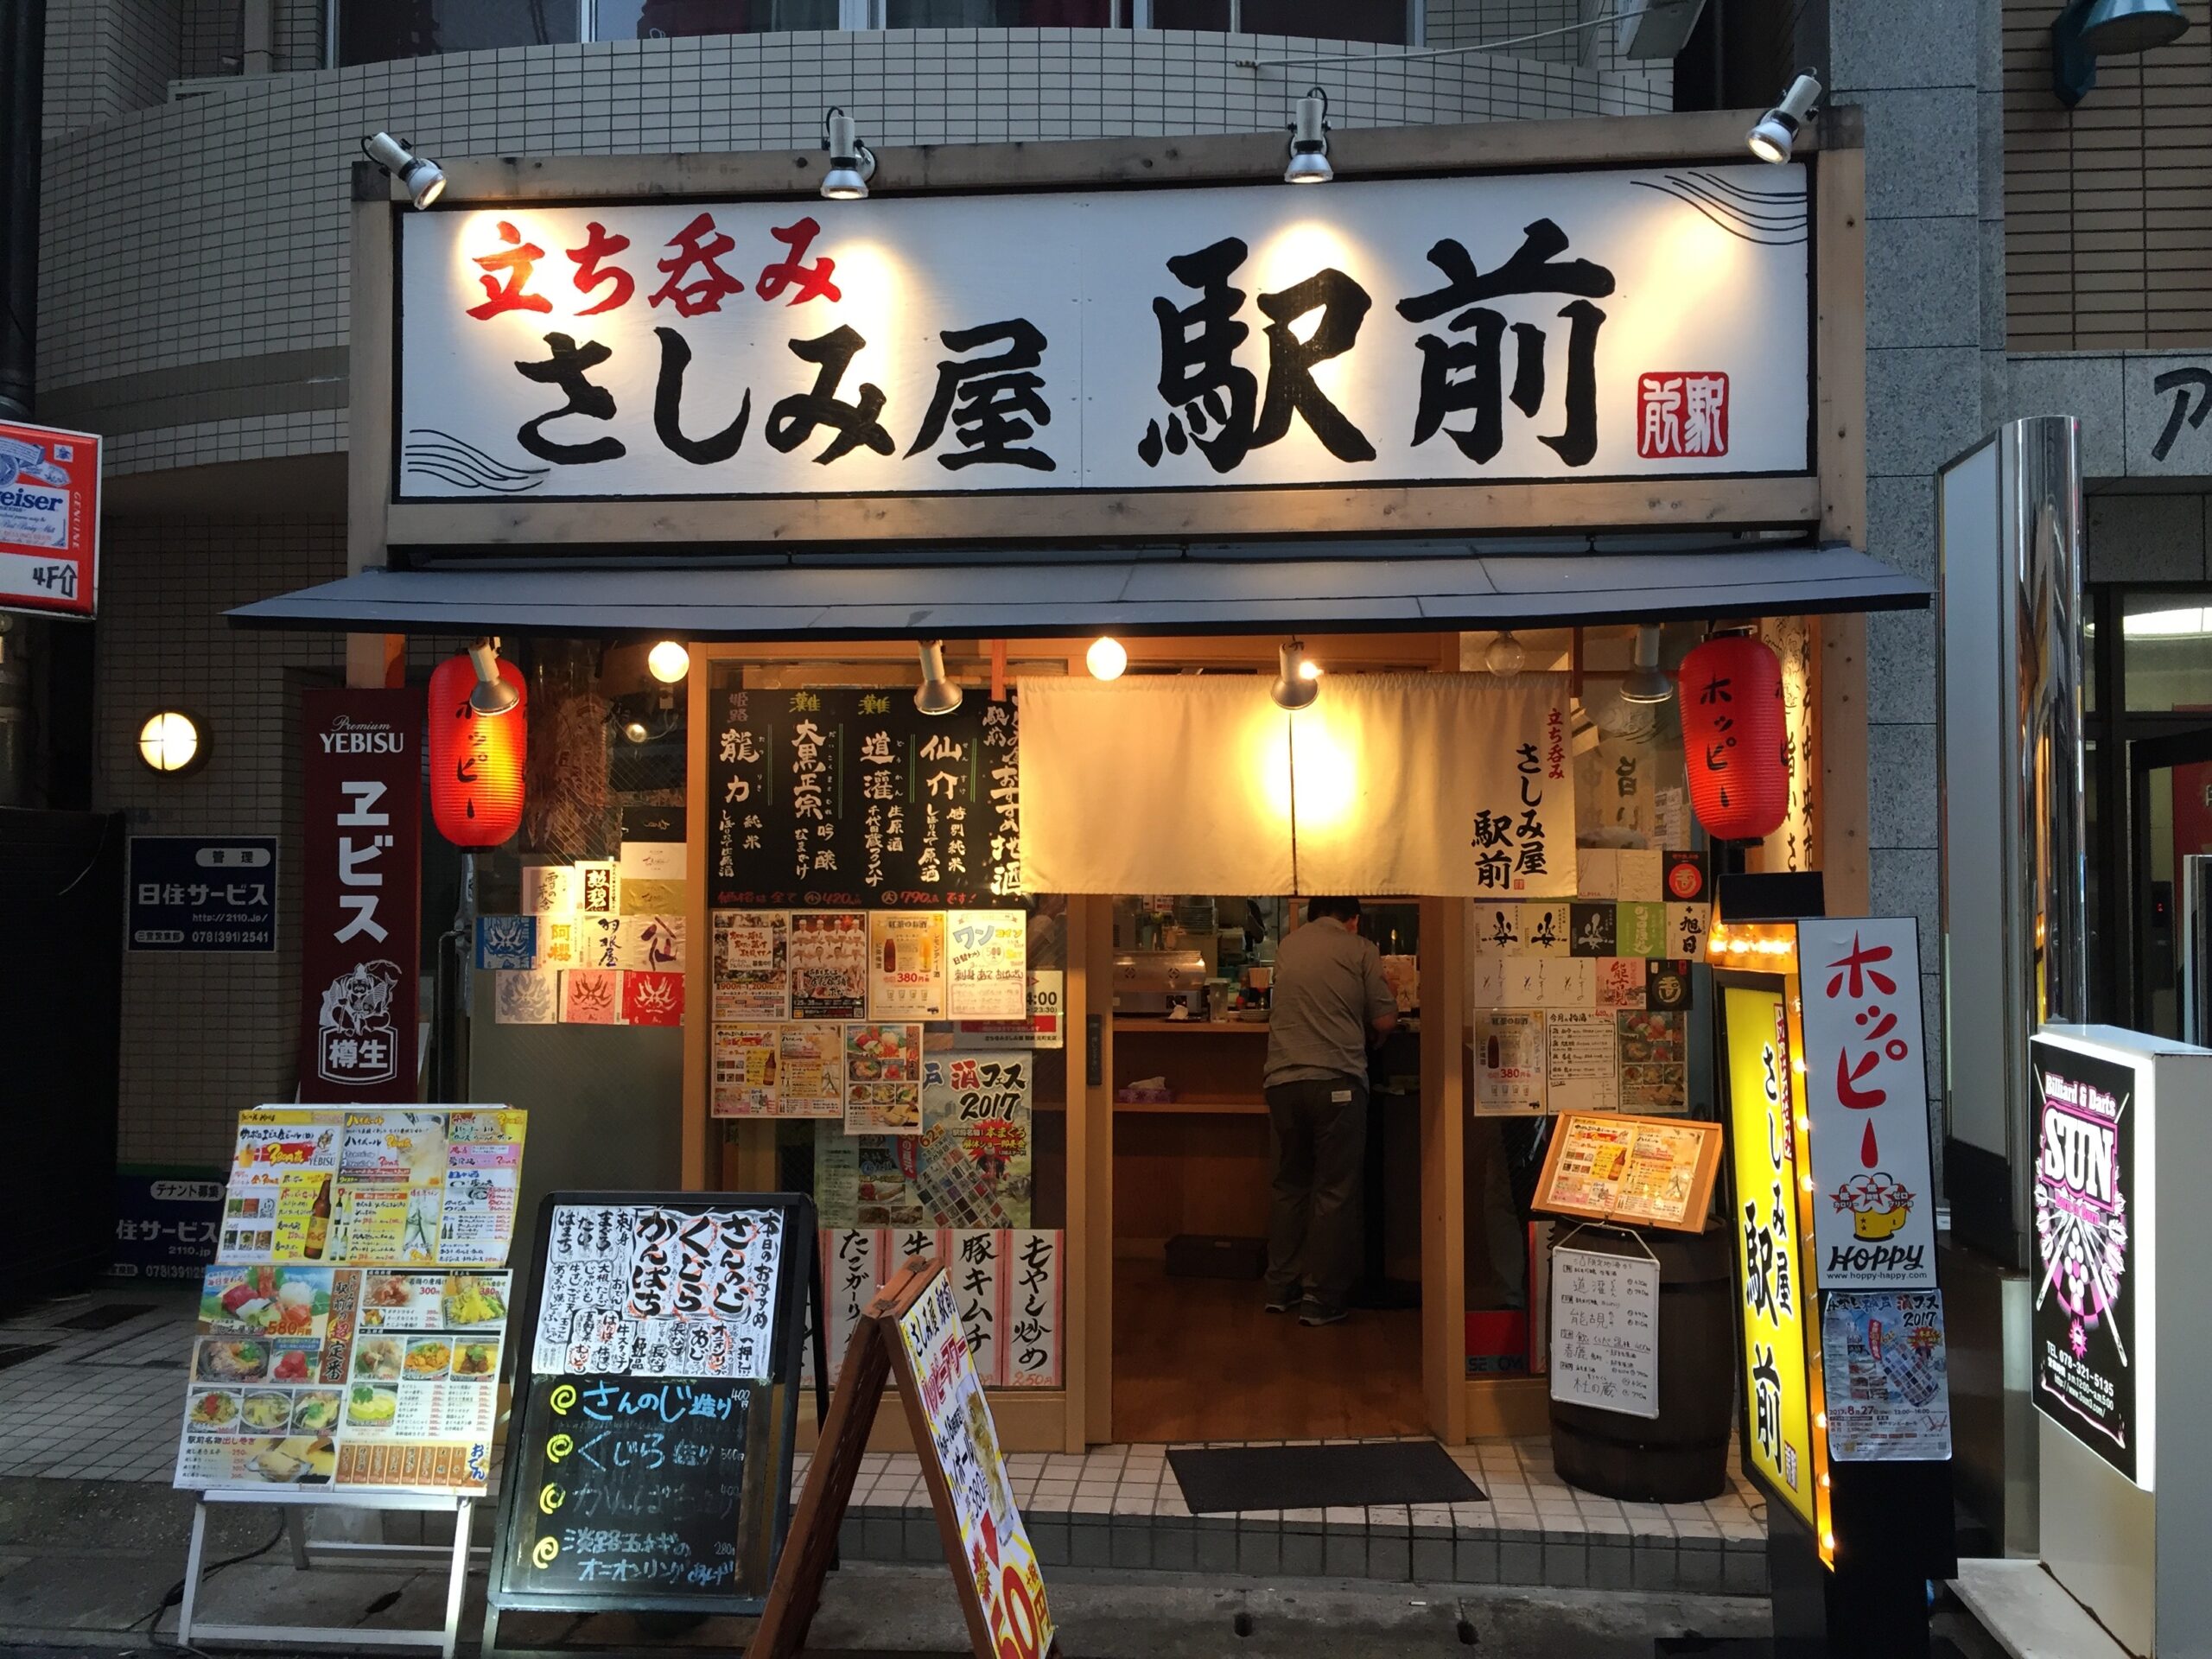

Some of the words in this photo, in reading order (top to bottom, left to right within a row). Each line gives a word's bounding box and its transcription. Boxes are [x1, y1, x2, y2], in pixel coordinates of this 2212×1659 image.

[466, 213, 842, 321] 立ち呑み
[514, 318, 1057, 472] さしみ屋
[1138, 217, 1616, 474] 駅前
[0, 488, 63, 512] eiser
[72, 491, 81, 549] GENUINE
[331, 715, 391, 732] Premium
[728, 692, 750, 723] 姫路
[319, 733, 404, 753] YEBISU
[720, 728, 760, 804] 龍力
[791, 719, 827, 820] 大黒正宗
[919, 734, 963, 800] 仙介
[1547, 708, 1565, 780] 立ち呑み
[1700, 674, 1737, 808] ホッピー
[743, 814, 763, 850] 純米
[886, 804, 905, 852] 生原酒
[946, 805, 967, 874] 特別純米
[1514, 743, 1548, 875] さしみ屋
[334, 781, 393, 944] ヱビス
[815, 823, 838, 871] 吟醸
[1471, 810, 1514, 891] 駅前
[138, 883, 269, 906] 日住サービス
[192, 931, 269, 943] 078(391)2541
[329, 1039, 388, 1070] 樽生
[950, 1059, 1027, 1090] 酒フェス
[1826, 931, 1908, 1168] ホッピー
[960, 1092, 1021, 1121] 2017
[2044, 1074, 2078, 1106] Billiard
[2088, 1088, 2117, 1119] Darts
[1763, 1045, 1793, 1317] さしみ屋
[2044, 1108, 2115, 1204] SUN
[156, 1184, 219, 1198] テナント募集
[714, 1214, 752, 1313] さんのじ
[753, 1212, 780, 1330] 本日のおすすめ
[1827, 1272, 1928, 1281] www.hoppy-happy.com
[960, 1234, 1000, 1356] 豚キムチ
[1013, 1234, 1054, 1372] もやし炒め
[1903, 1312, 1937, 1328] 2017
[1744, 1200, 1784, 1476] 駅前
[2046, 1339, 2057, 1359] TEL
[2059, 1349, 2114, 1397] 078-321-5135
[468, 1443, 486, 1480] おでん
